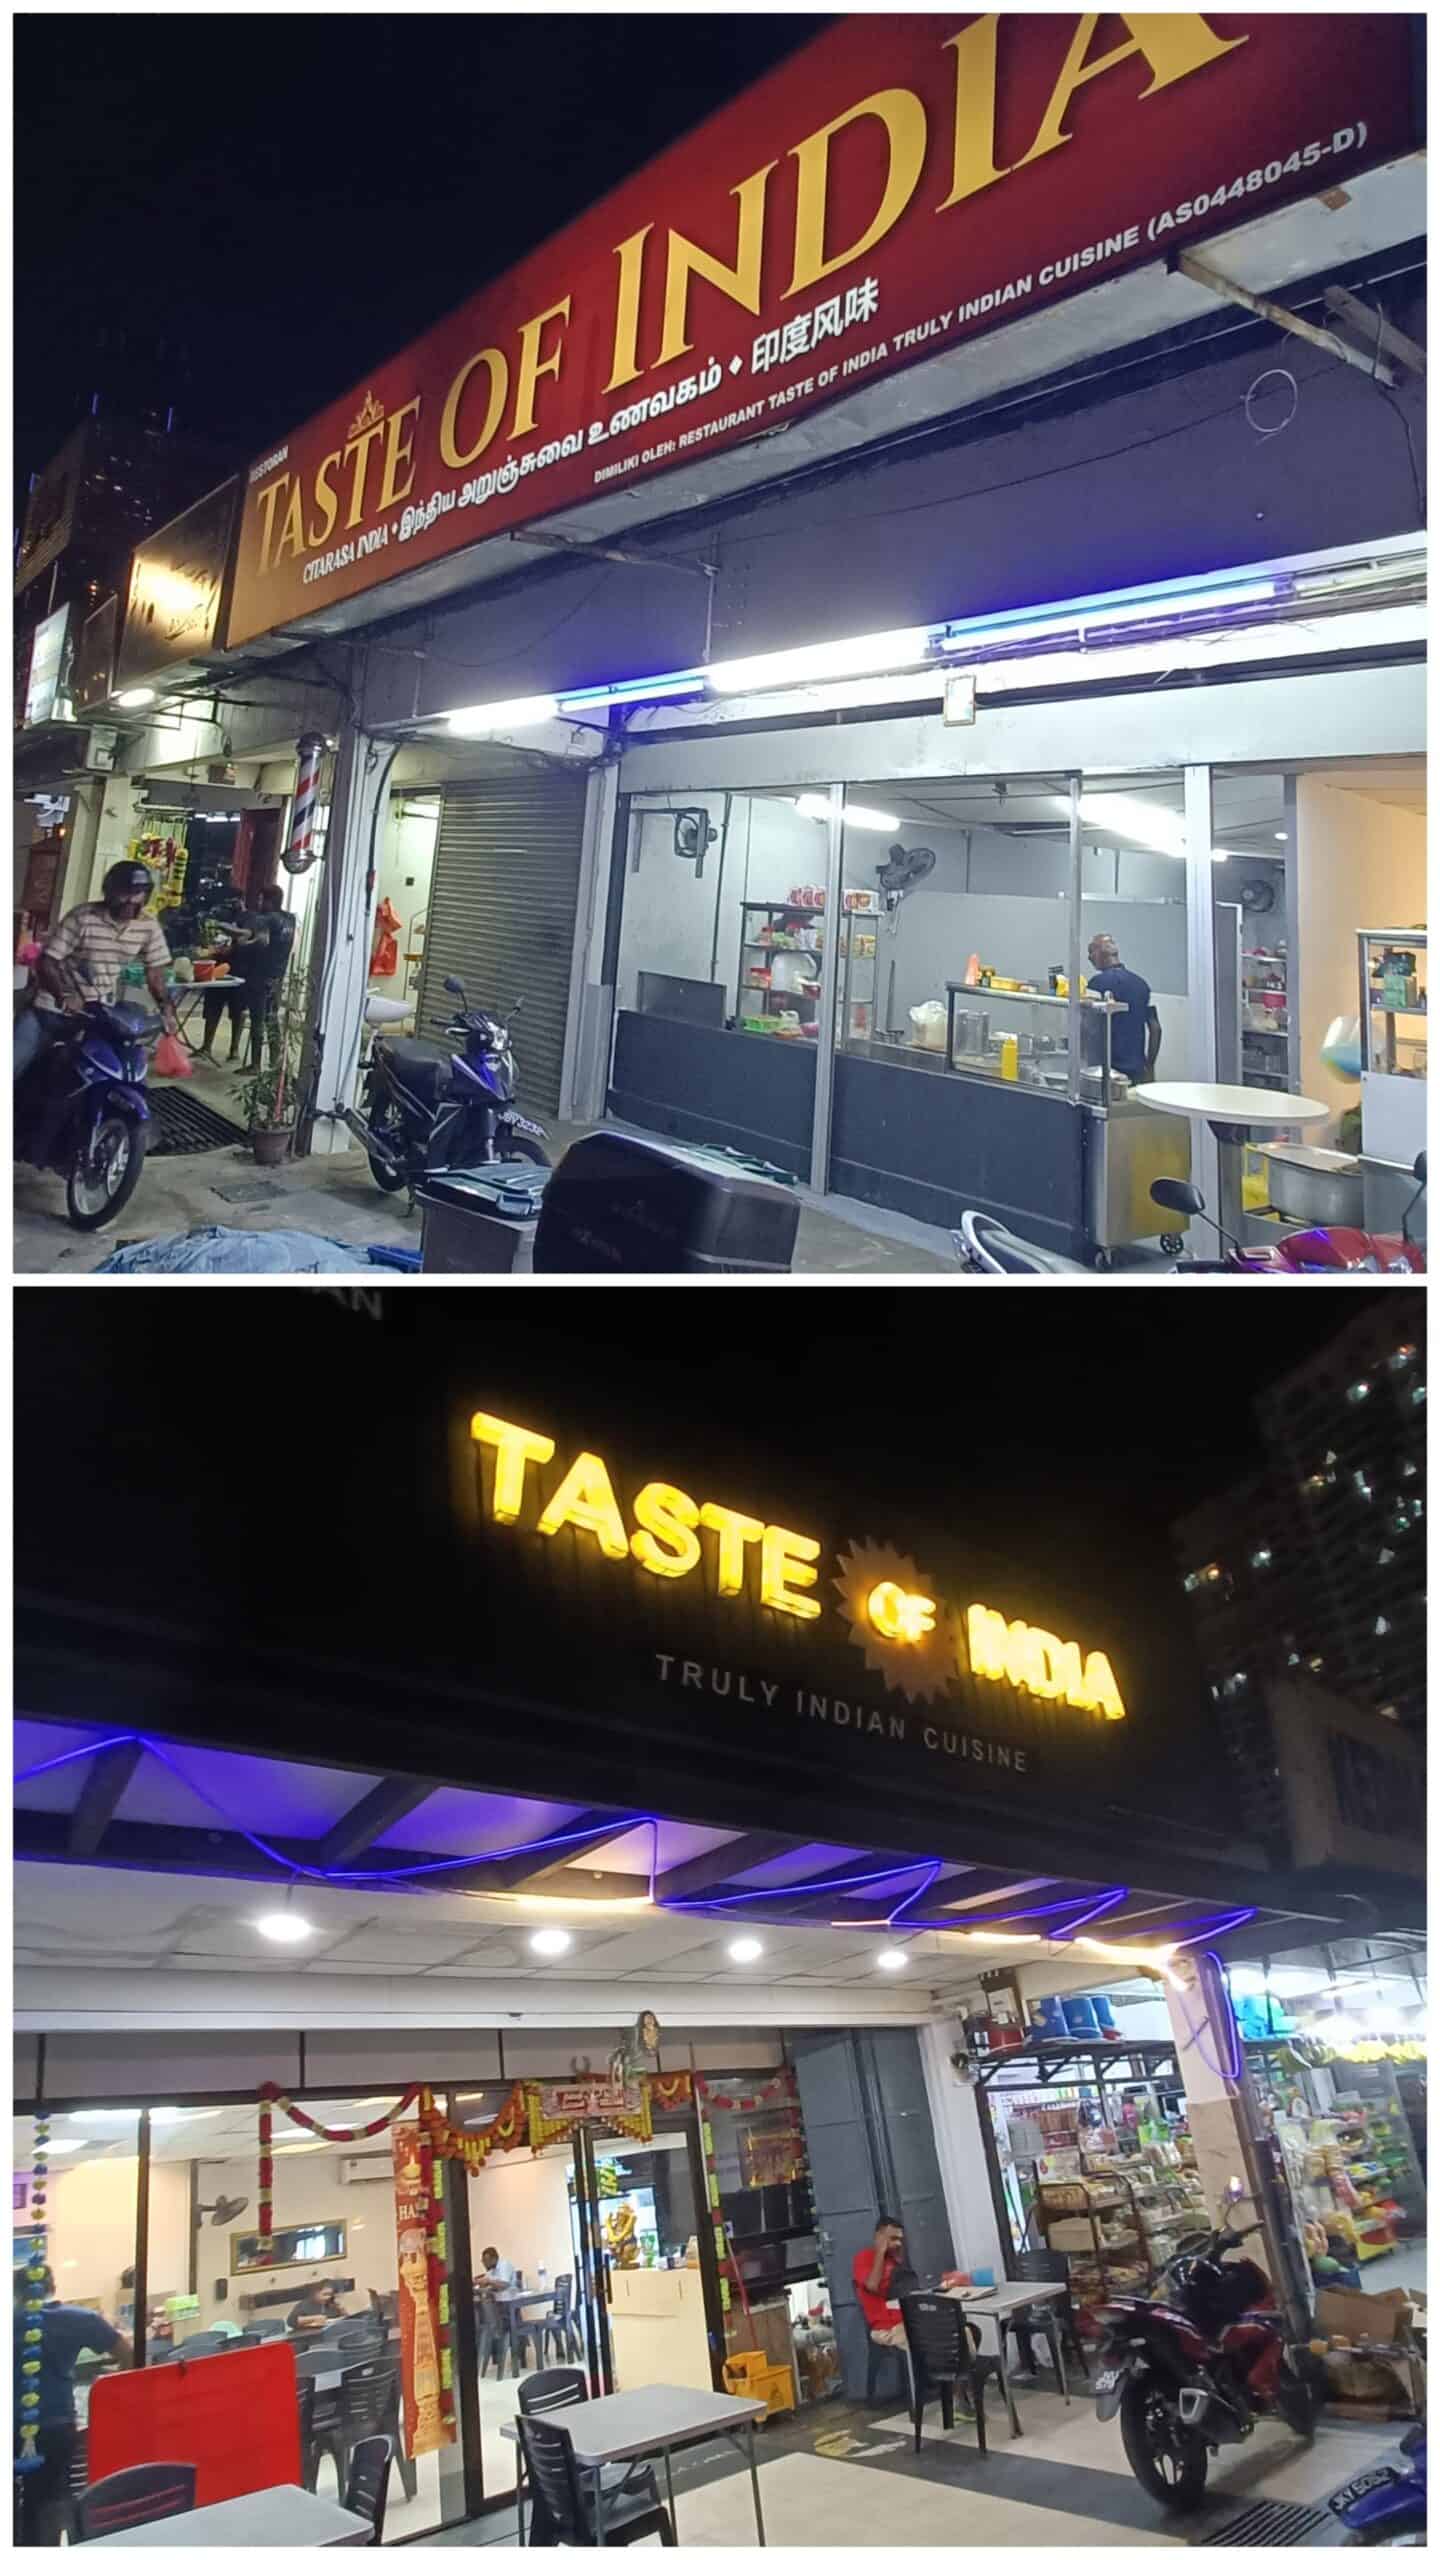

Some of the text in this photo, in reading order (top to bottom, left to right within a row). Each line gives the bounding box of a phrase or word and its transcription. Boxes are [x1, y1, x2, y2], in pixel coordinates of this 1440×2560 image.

[256, 13, 1249, 576] TASTE OF INDIA
[594, 120, 1368, 483] DIMILIKI OLEH: RESTAURANT TASTE OF INDIA TRULY INDIAN CUISINE (AS0448045-D)
[751, 276, 880, 374] 印度风味
[398, 489, 457, 542] இந்திய
[587, 356, 723, 446] உணவகம்
[303, 523, 389, 584] CITARASA INDIA
[471, 1411, 1126, 1720] TASTE OF INDIA
[655, 1654, 1028, 1773] TRULY INDIAN CUISINE
